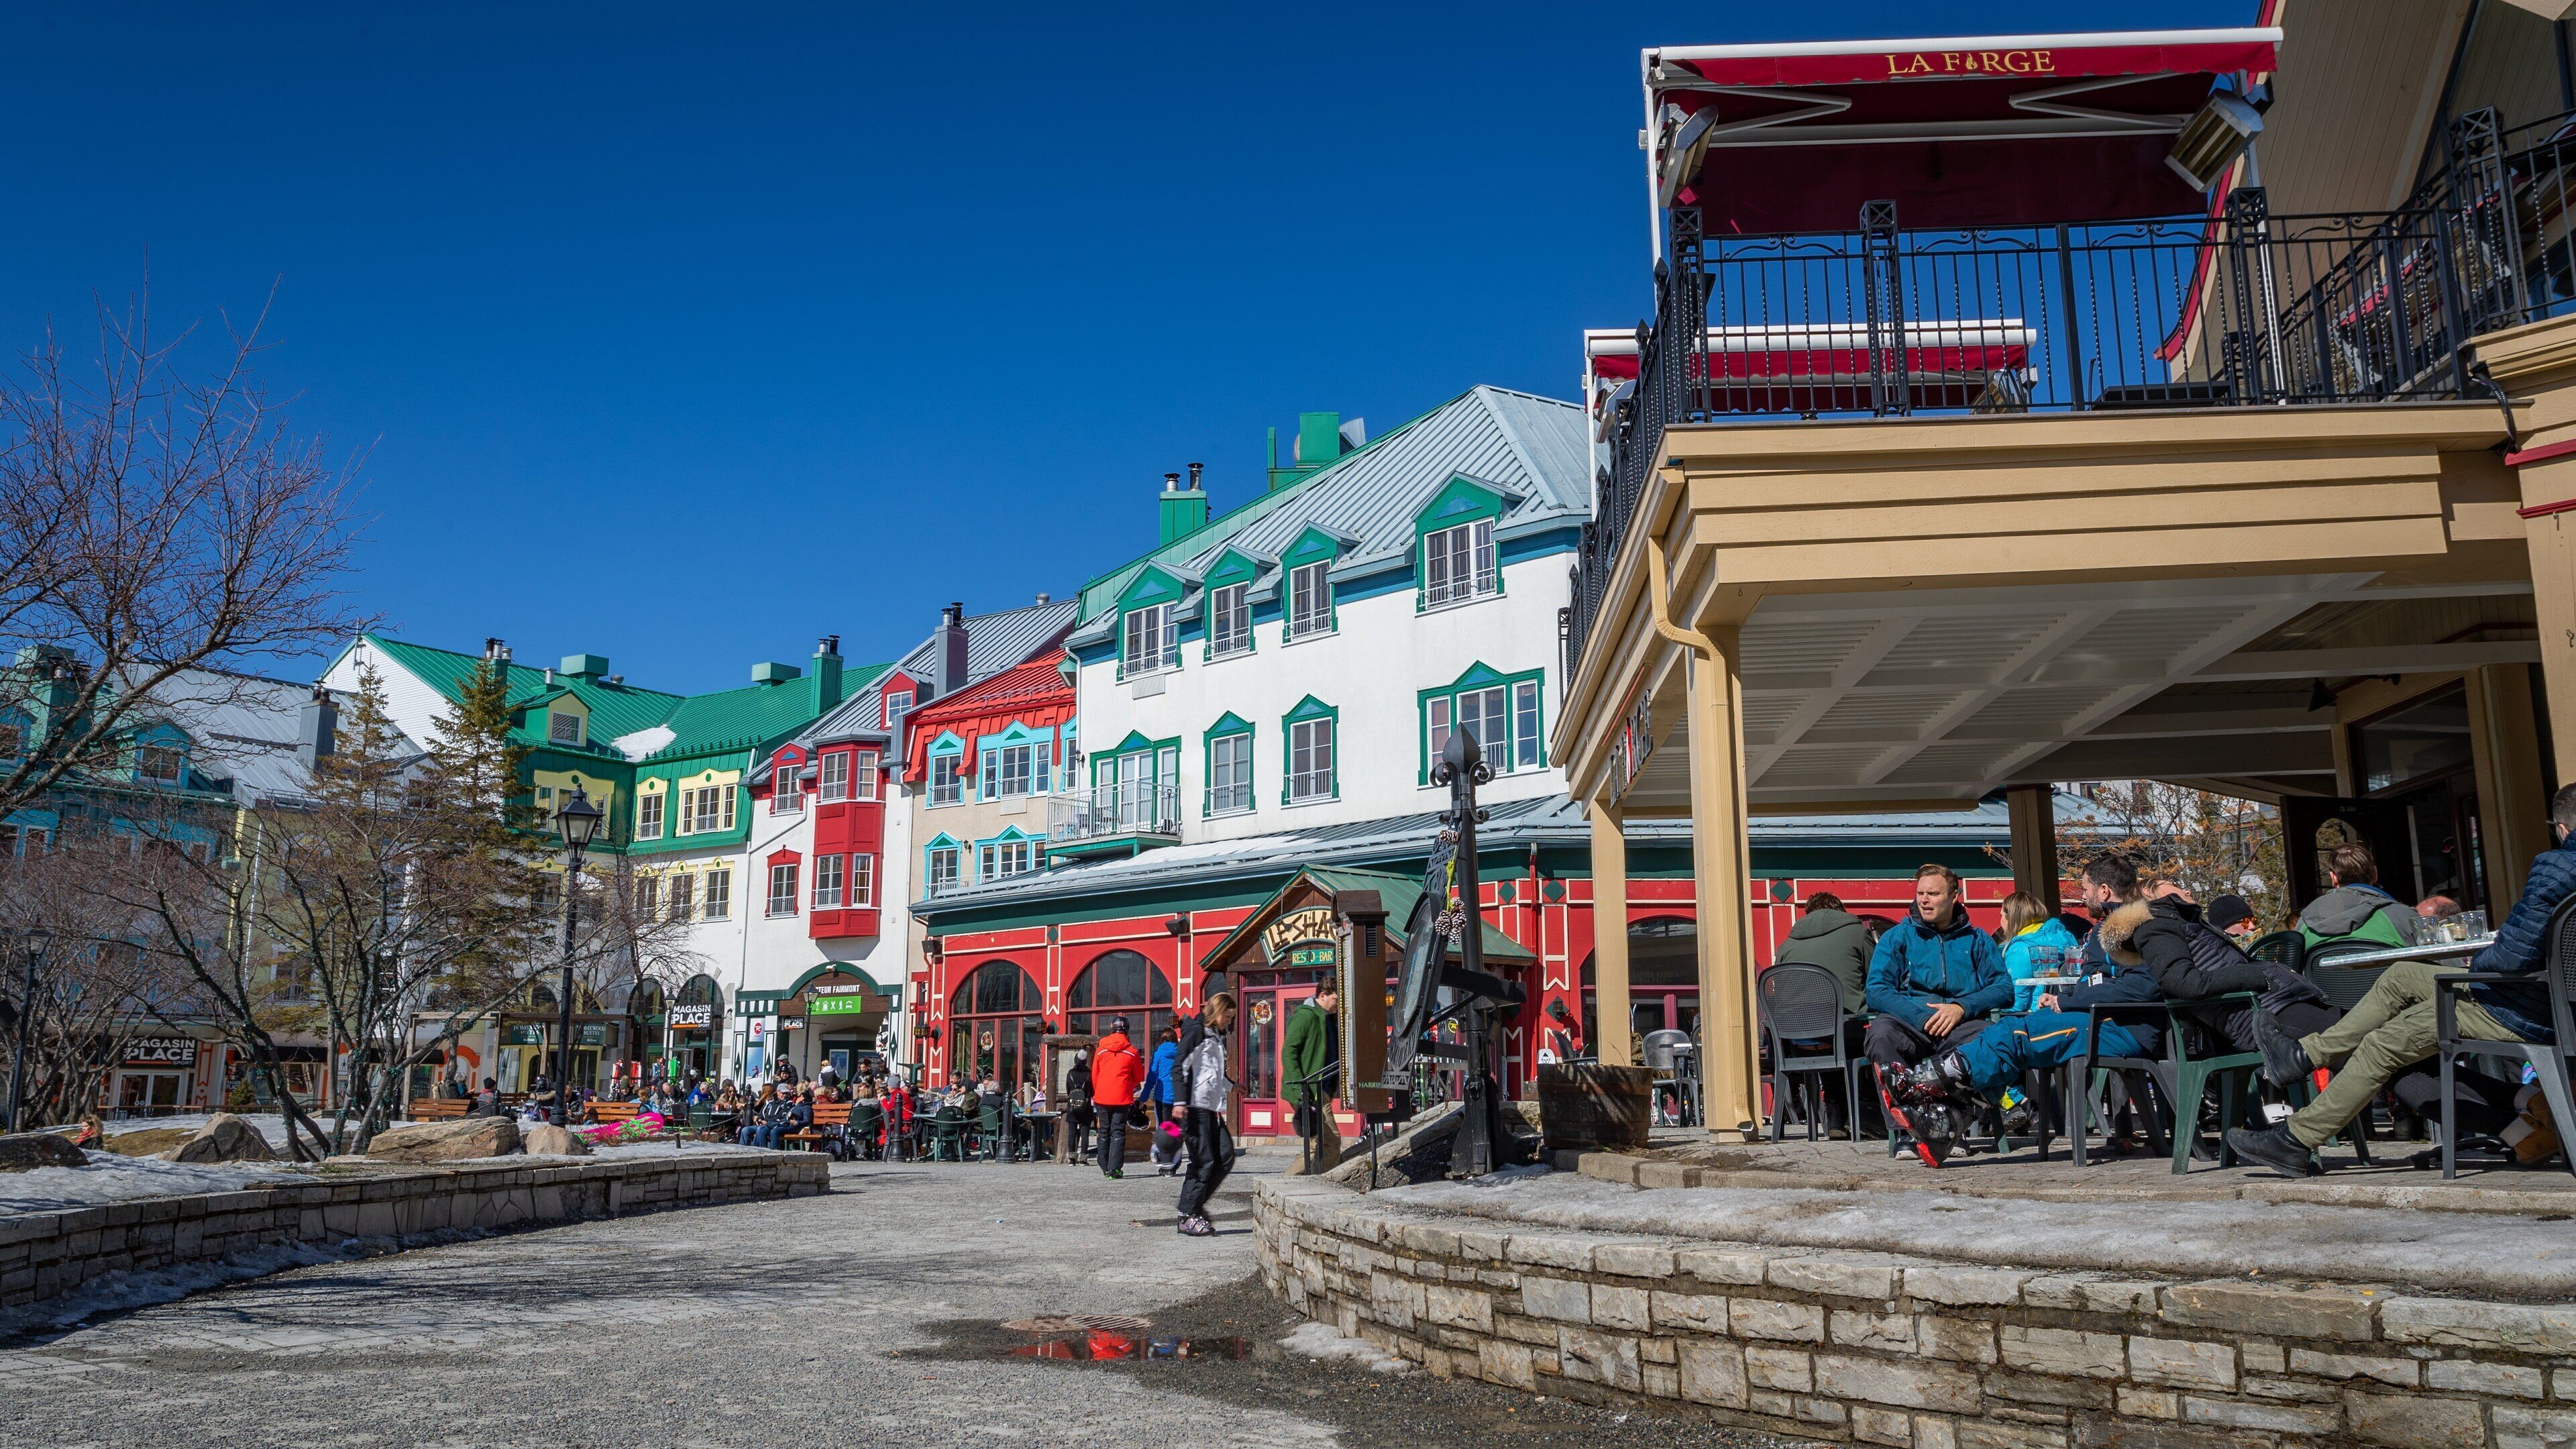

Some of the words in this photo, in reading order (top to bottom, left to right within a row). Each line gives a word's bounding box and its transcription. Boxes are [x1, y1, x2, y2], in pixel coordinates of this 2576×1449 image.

[1885, 54, 1935, 74] LA
[1268, 920, 1291, 952] LE
[1292, 951, 1333, 964] RESO-BAR
[833, 984, 860, 994] FAIRMONT
[673, 1004, 711, 1014] MAGASIN
[672, 1013, 710, 1024] PLACE
[126, 1048, 195, 1061] PLACE
